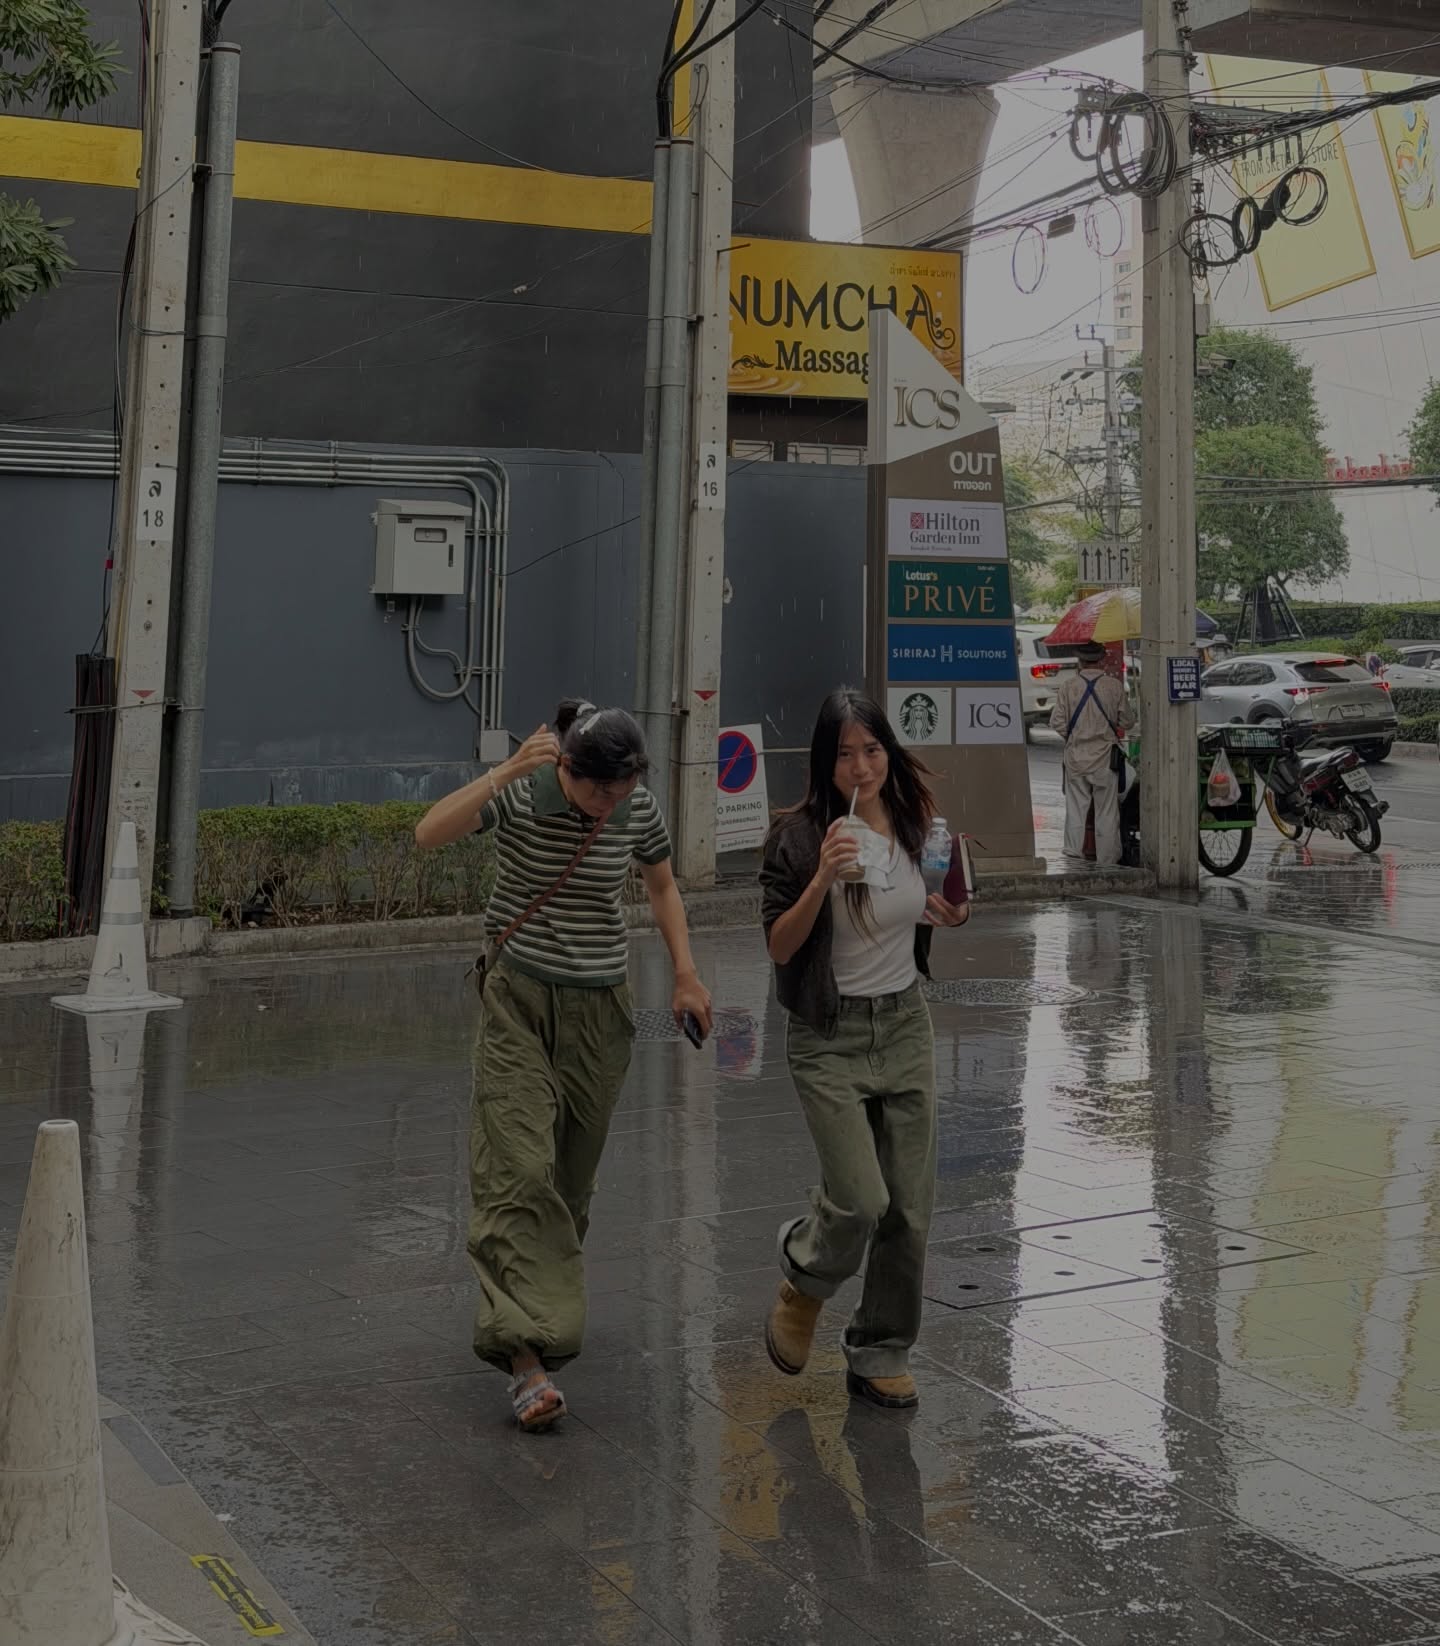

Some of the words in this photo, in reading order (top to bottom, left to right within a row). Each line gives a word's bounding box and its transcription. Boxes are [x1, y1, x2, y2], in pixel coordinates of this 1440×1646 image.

[894, 386, 961, 431] ICS
[949, 450, 997, 476] OUT
[703, 481, 718, 497] 16
[953, 480, 992, 491] ทางออก
[143, 509, 164, 528] 18
[926, 512, 981, 532] Hilton
[910, 530, 956, 545] Garden
[958, 532, 981, 545] Inn
[905, 570, 939, 582] Lotus's
[903, 576, 996, 614] PRIVÉ
[892, 647, 937, 660] SIRIRAJ
[957, 648, 1008, 661] SOLUTIONS
[1173, 674, 1197, 682] BEER
[1173, 682, 1197, 690] BAR
[968, 702, 1012, 729] ICS
[725, 801, 762, 813] PARKING
